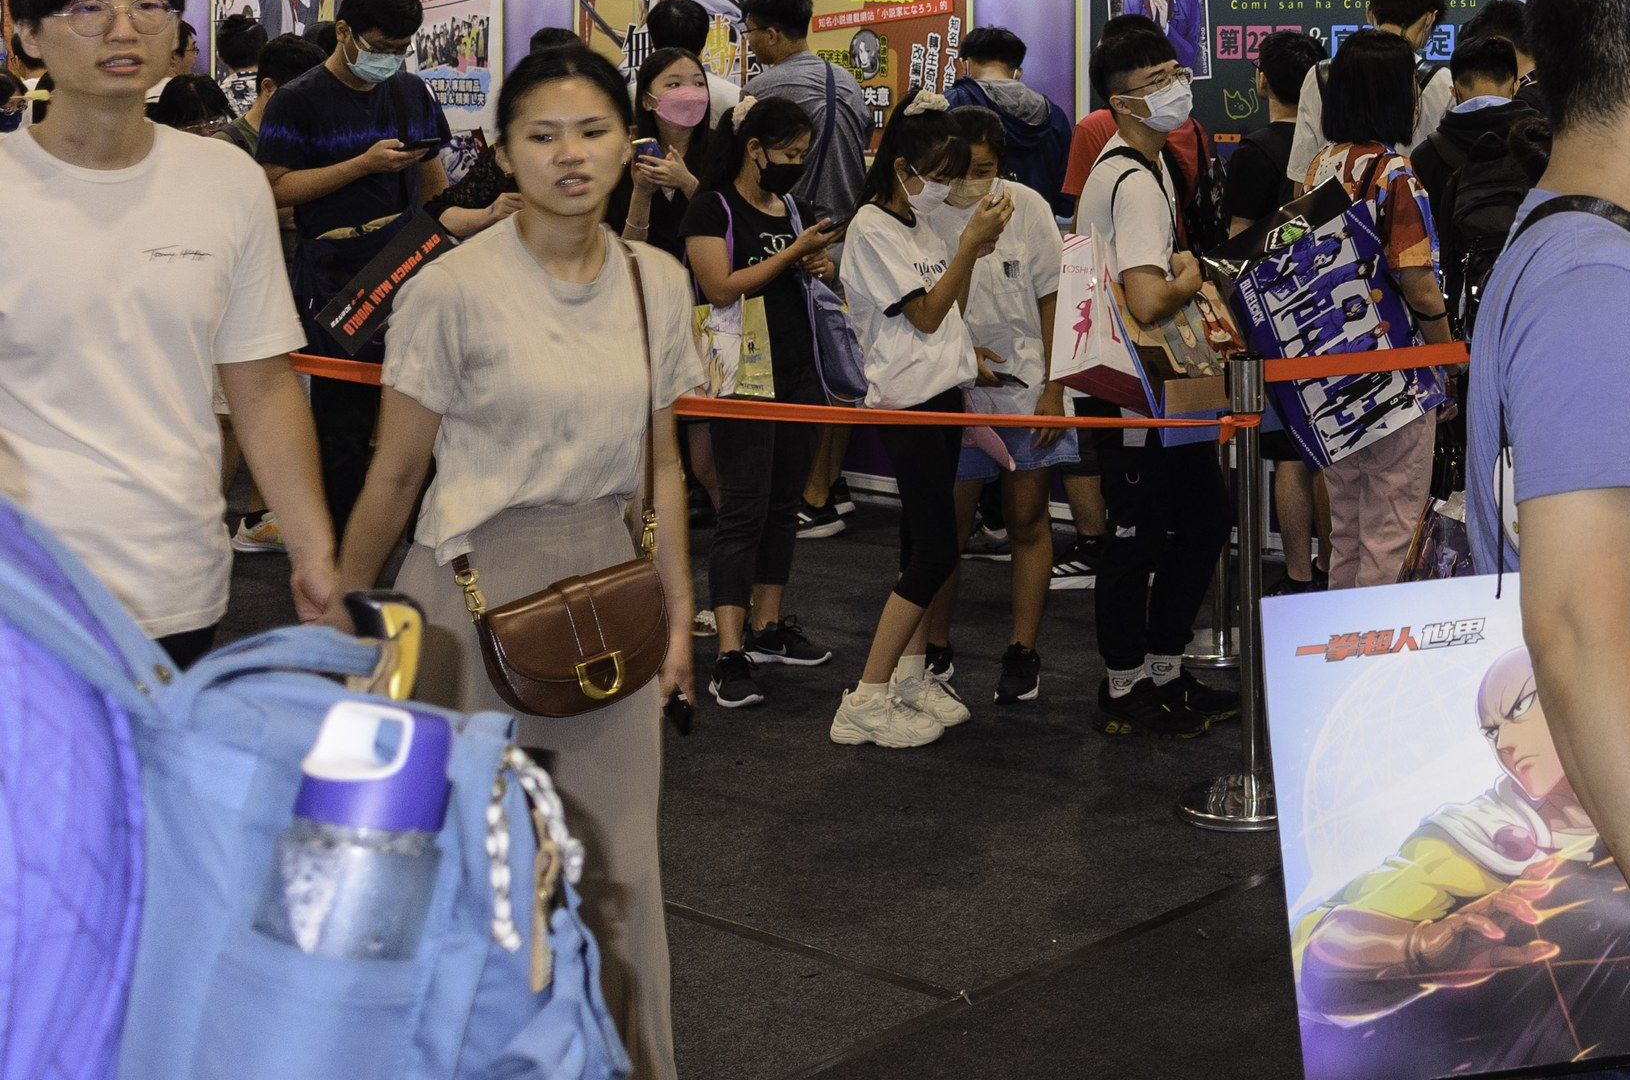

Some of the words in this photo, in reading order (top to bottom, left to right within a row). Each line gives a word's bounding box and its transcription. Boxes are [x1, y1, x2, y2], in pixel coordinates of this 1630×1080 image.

[1279, 0, 1304, 9] san
[420, 233, 442, 255] ONE
[390, 250, 423, 284] PUNCH
[369, 279, 394, 305] MAN
[342, 300, 376, 336] WORLD
[1295, 618, 1485, 662] 一拳超人世界
